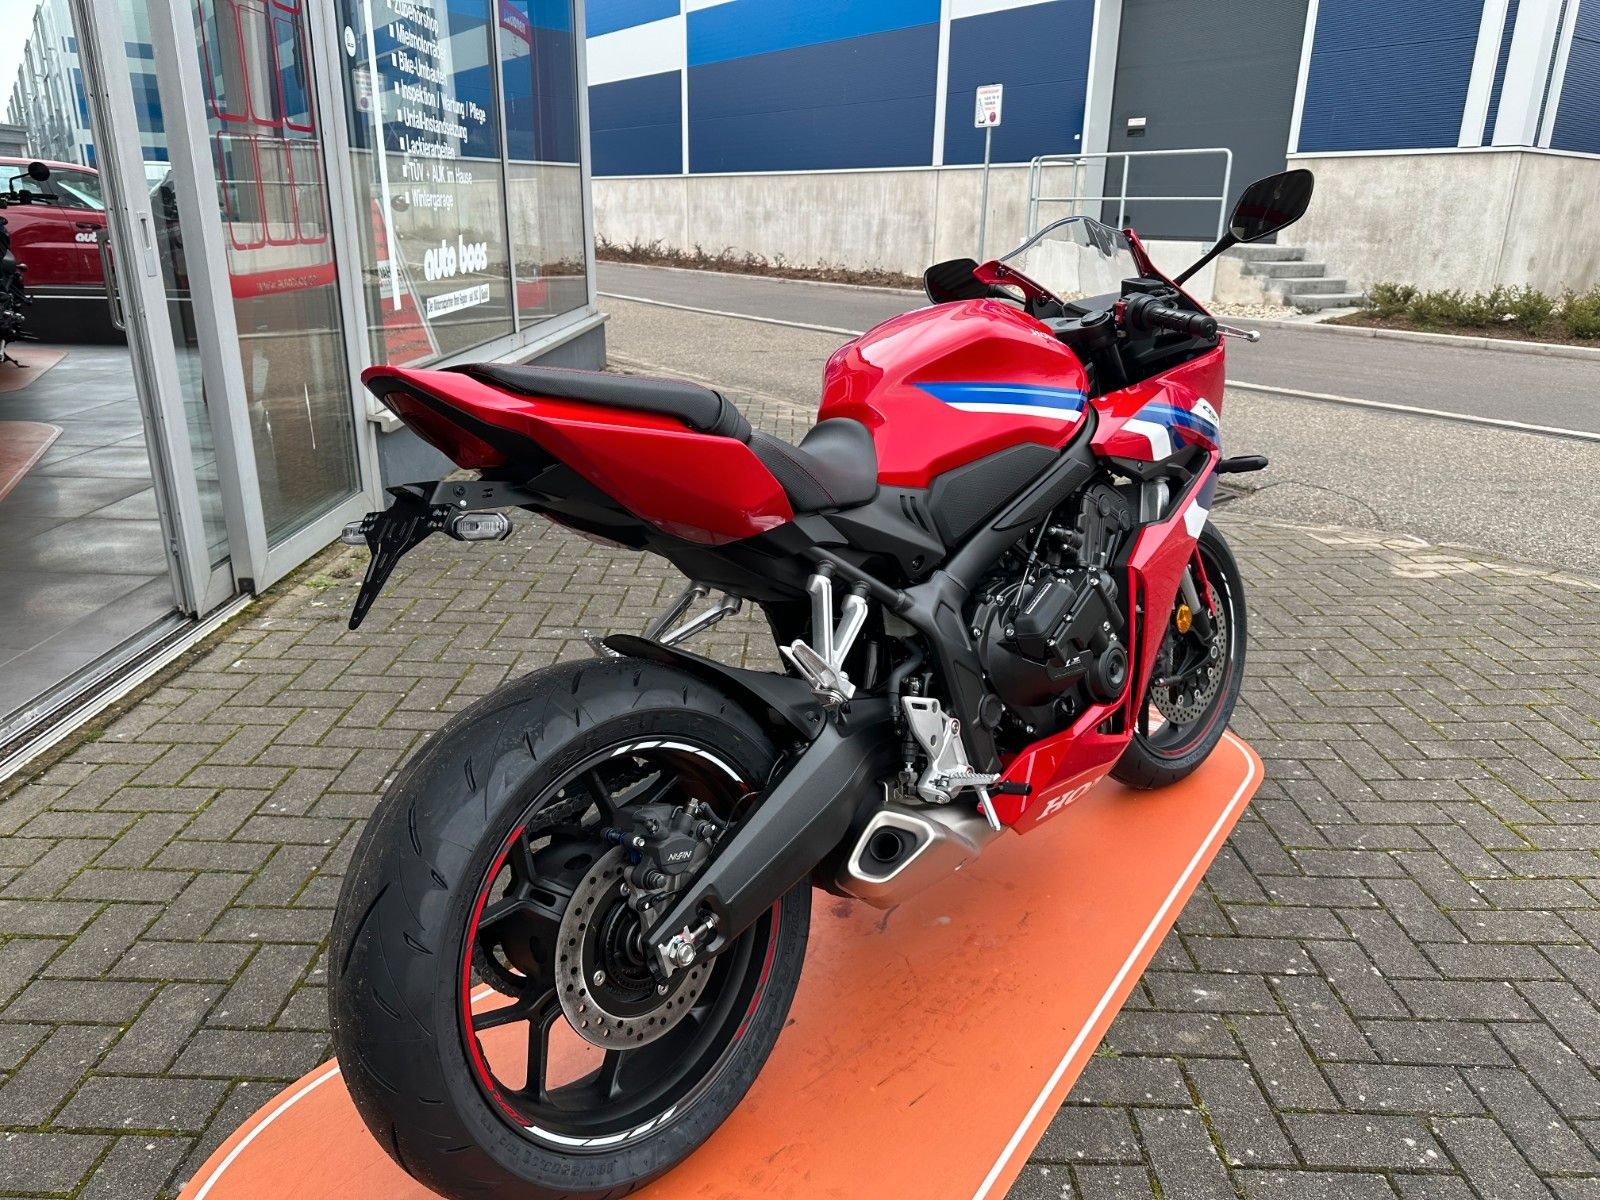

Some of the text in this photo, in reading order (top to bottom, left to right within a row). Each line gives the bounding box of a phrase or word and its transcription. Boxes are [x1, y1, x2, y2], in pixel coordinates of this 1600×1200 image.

[398, 50, 448, 86] Bike-Umbauten
[401, 78, 436, 107] Inspektion
[440, 92, 465, 119] Wartung
[469, 101, 486, 125] Pflege
[403, 106, 467, 144] Unfall-Instandsetzung
[406, 134, 456, 160] Lackierarbeiten
[409, 159, 424, 182] TÜV
[455, 167, 472, 184] Hause
[411, 188, 454, 211] Wintergarage
[75, 231, 97, 243] aut
[424, 234, 487, 281] auto boos
